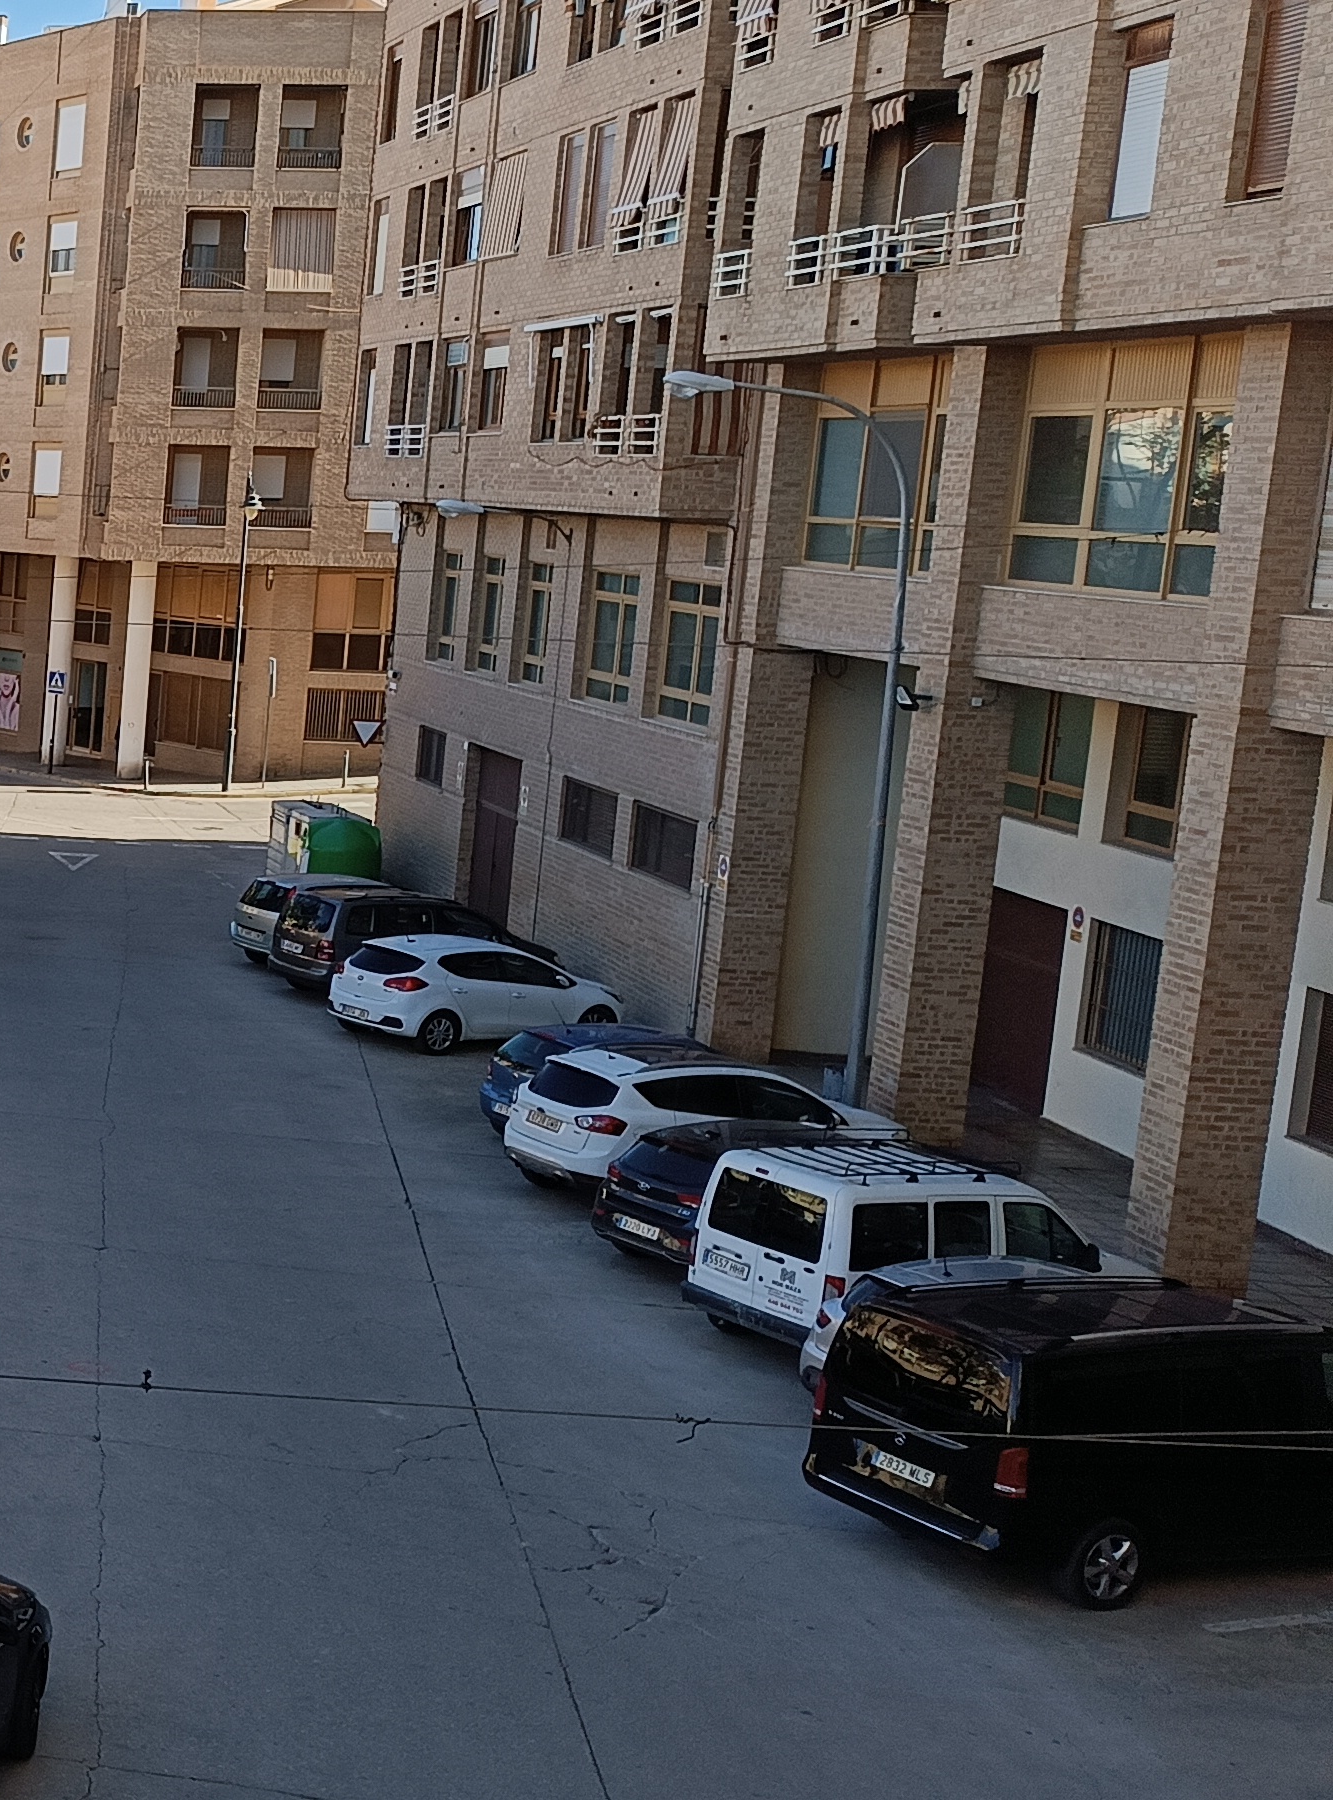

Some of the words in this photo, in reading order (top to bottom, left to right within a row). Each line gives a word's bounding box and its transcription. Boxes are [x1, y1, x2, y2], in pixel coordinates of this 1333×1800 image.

[709, 1253, 729, 1268] 5557
[879, 1454, 908, 1475] 2832
[908, 1465, 932, 1484] MLS
